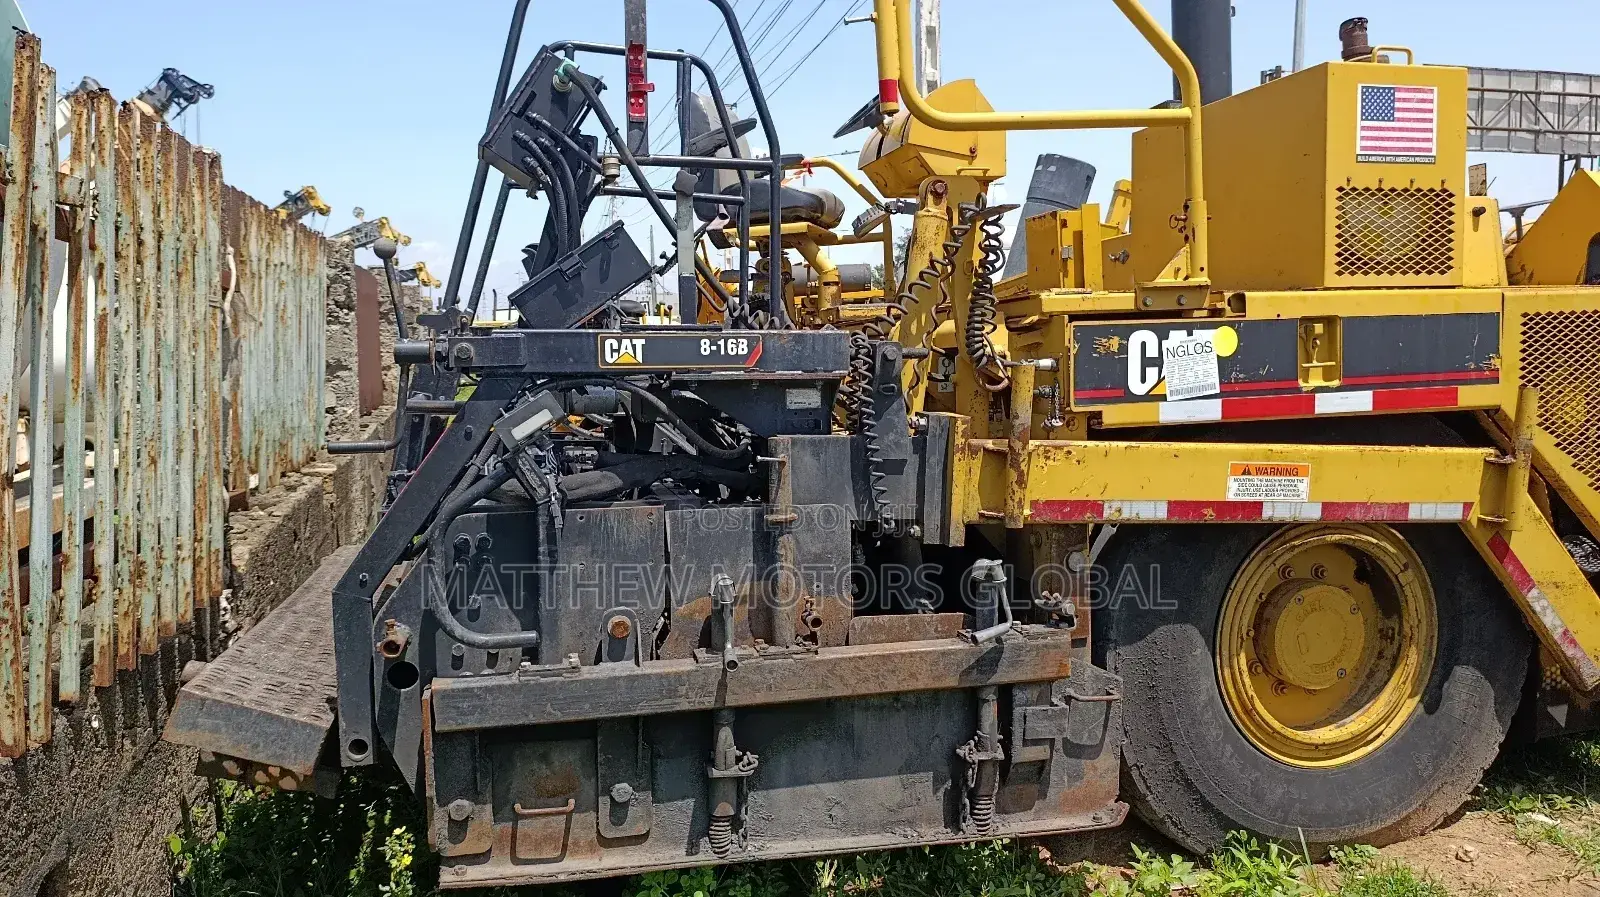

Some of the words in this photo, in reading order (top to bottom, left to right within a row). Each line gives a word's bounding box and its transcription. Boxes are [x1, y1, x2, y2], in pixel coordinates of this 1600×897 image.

[604, 338, 646, 364] CAT
[700, 338, 749, 356] 8-16B
[1166, 340, 1213, 359] NGLOS
[1255, 466, 1299, 477] WARNING
